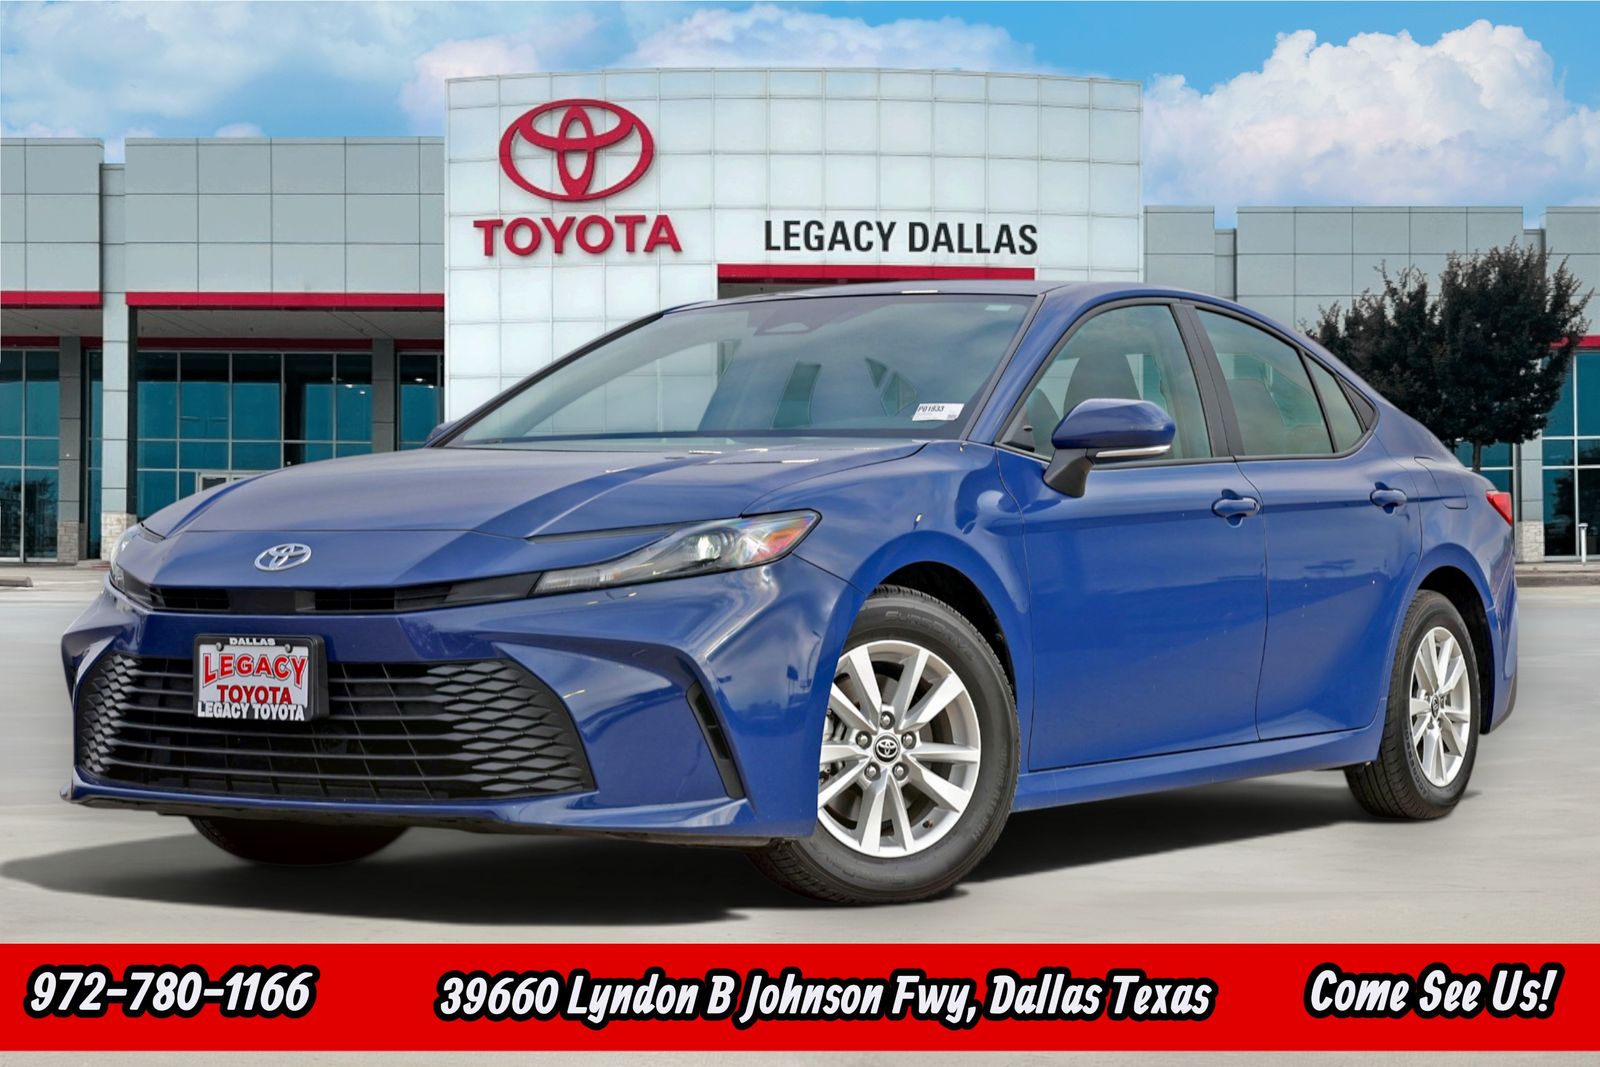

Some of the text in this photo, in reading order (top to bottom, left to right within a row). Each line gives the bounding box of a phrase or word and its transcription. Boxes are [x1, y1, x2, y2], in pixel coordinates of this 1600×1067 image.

[474, 214, 682, 257] TOYOTA
[765, 220, 1038, 255] LEGACY DALLAS
[229, 637, 276, 646] DALLAS
[203, 653, 308, 689] LEGACY
[217, 685, 292, 704] TOYOTA
[198, 701, 305, 721] LEGACY TOYOTA
